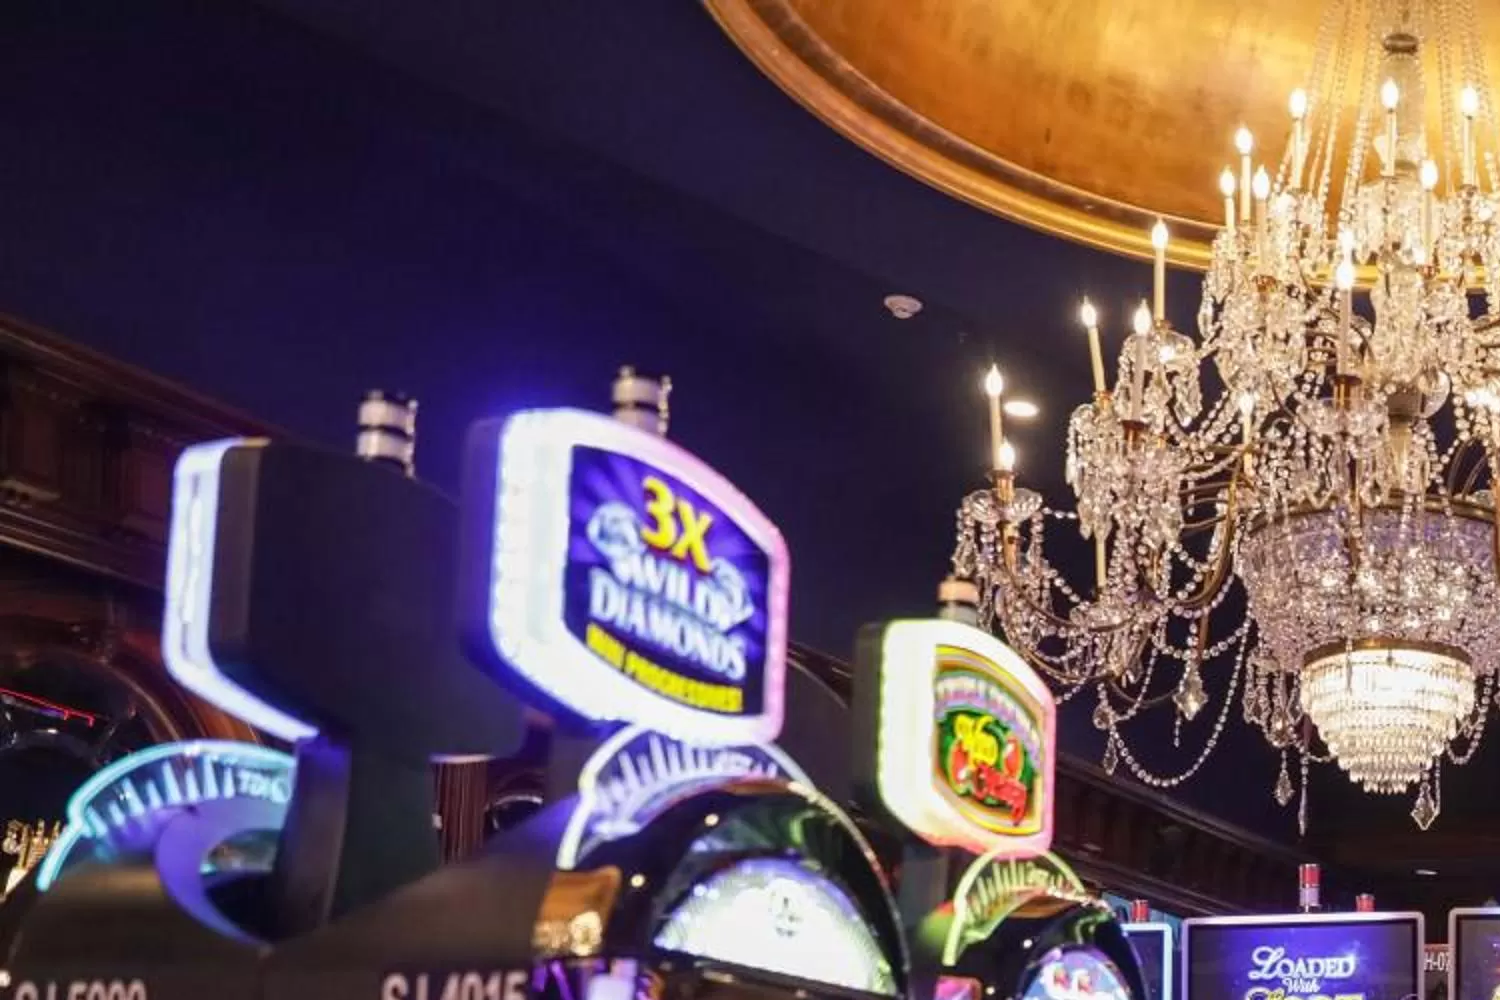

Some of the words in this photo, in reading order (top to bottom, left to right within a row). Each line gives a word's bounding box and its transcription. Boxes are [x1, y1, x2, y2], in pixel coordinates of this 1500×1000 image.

[642, 475, 712, 574] 3X
[589, 566, 747, 680] DIAMONDS
[1248, 945, 1357, 979] LOADED
[1281, 977, 1320, 993] With
